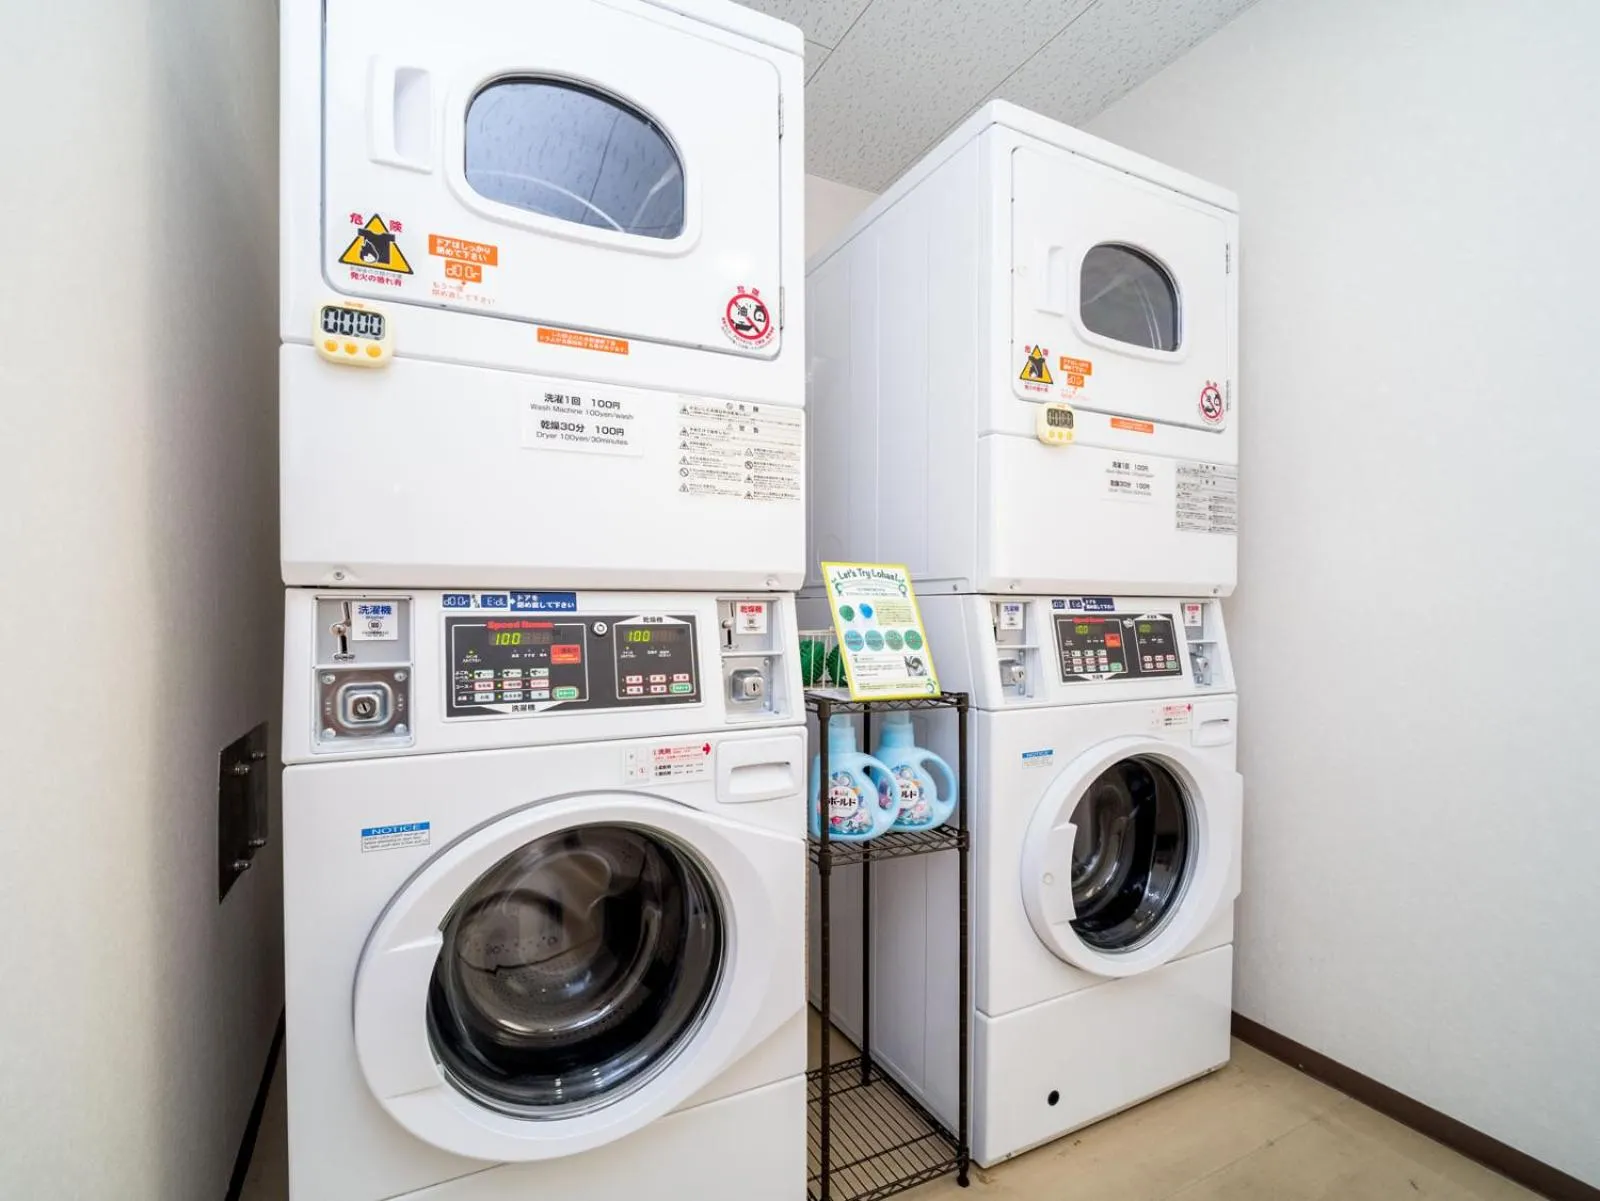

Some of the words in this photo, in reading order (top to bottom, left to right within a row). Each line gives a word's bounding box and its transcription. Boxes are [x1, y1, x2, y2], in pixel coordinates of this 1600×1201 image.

[350, 212, 363, 225] 危
[389, 220, 403, 233] 険
[436, 238, 491, 254] ドアはしっかり
[544, 393, 581, 406] 洗濯1回
[591, 398, 621, 410] 100円
[530, 403, 551, 412] Wash
[552, 405, 583, 415] Machine
[585, 409, 635, 421] 100yen/wash
[540, 419, 585, 433] 乾燥30分
[595, 425, 625, 436] 100円
[536, 431, 558, 440] Dryer
[358, 604, 393, 615] 洗濯機
[495, 632, 521, 645] 100
[628, 630, 650, 642] 100
[371, 824, 418, 835] NOTICE
